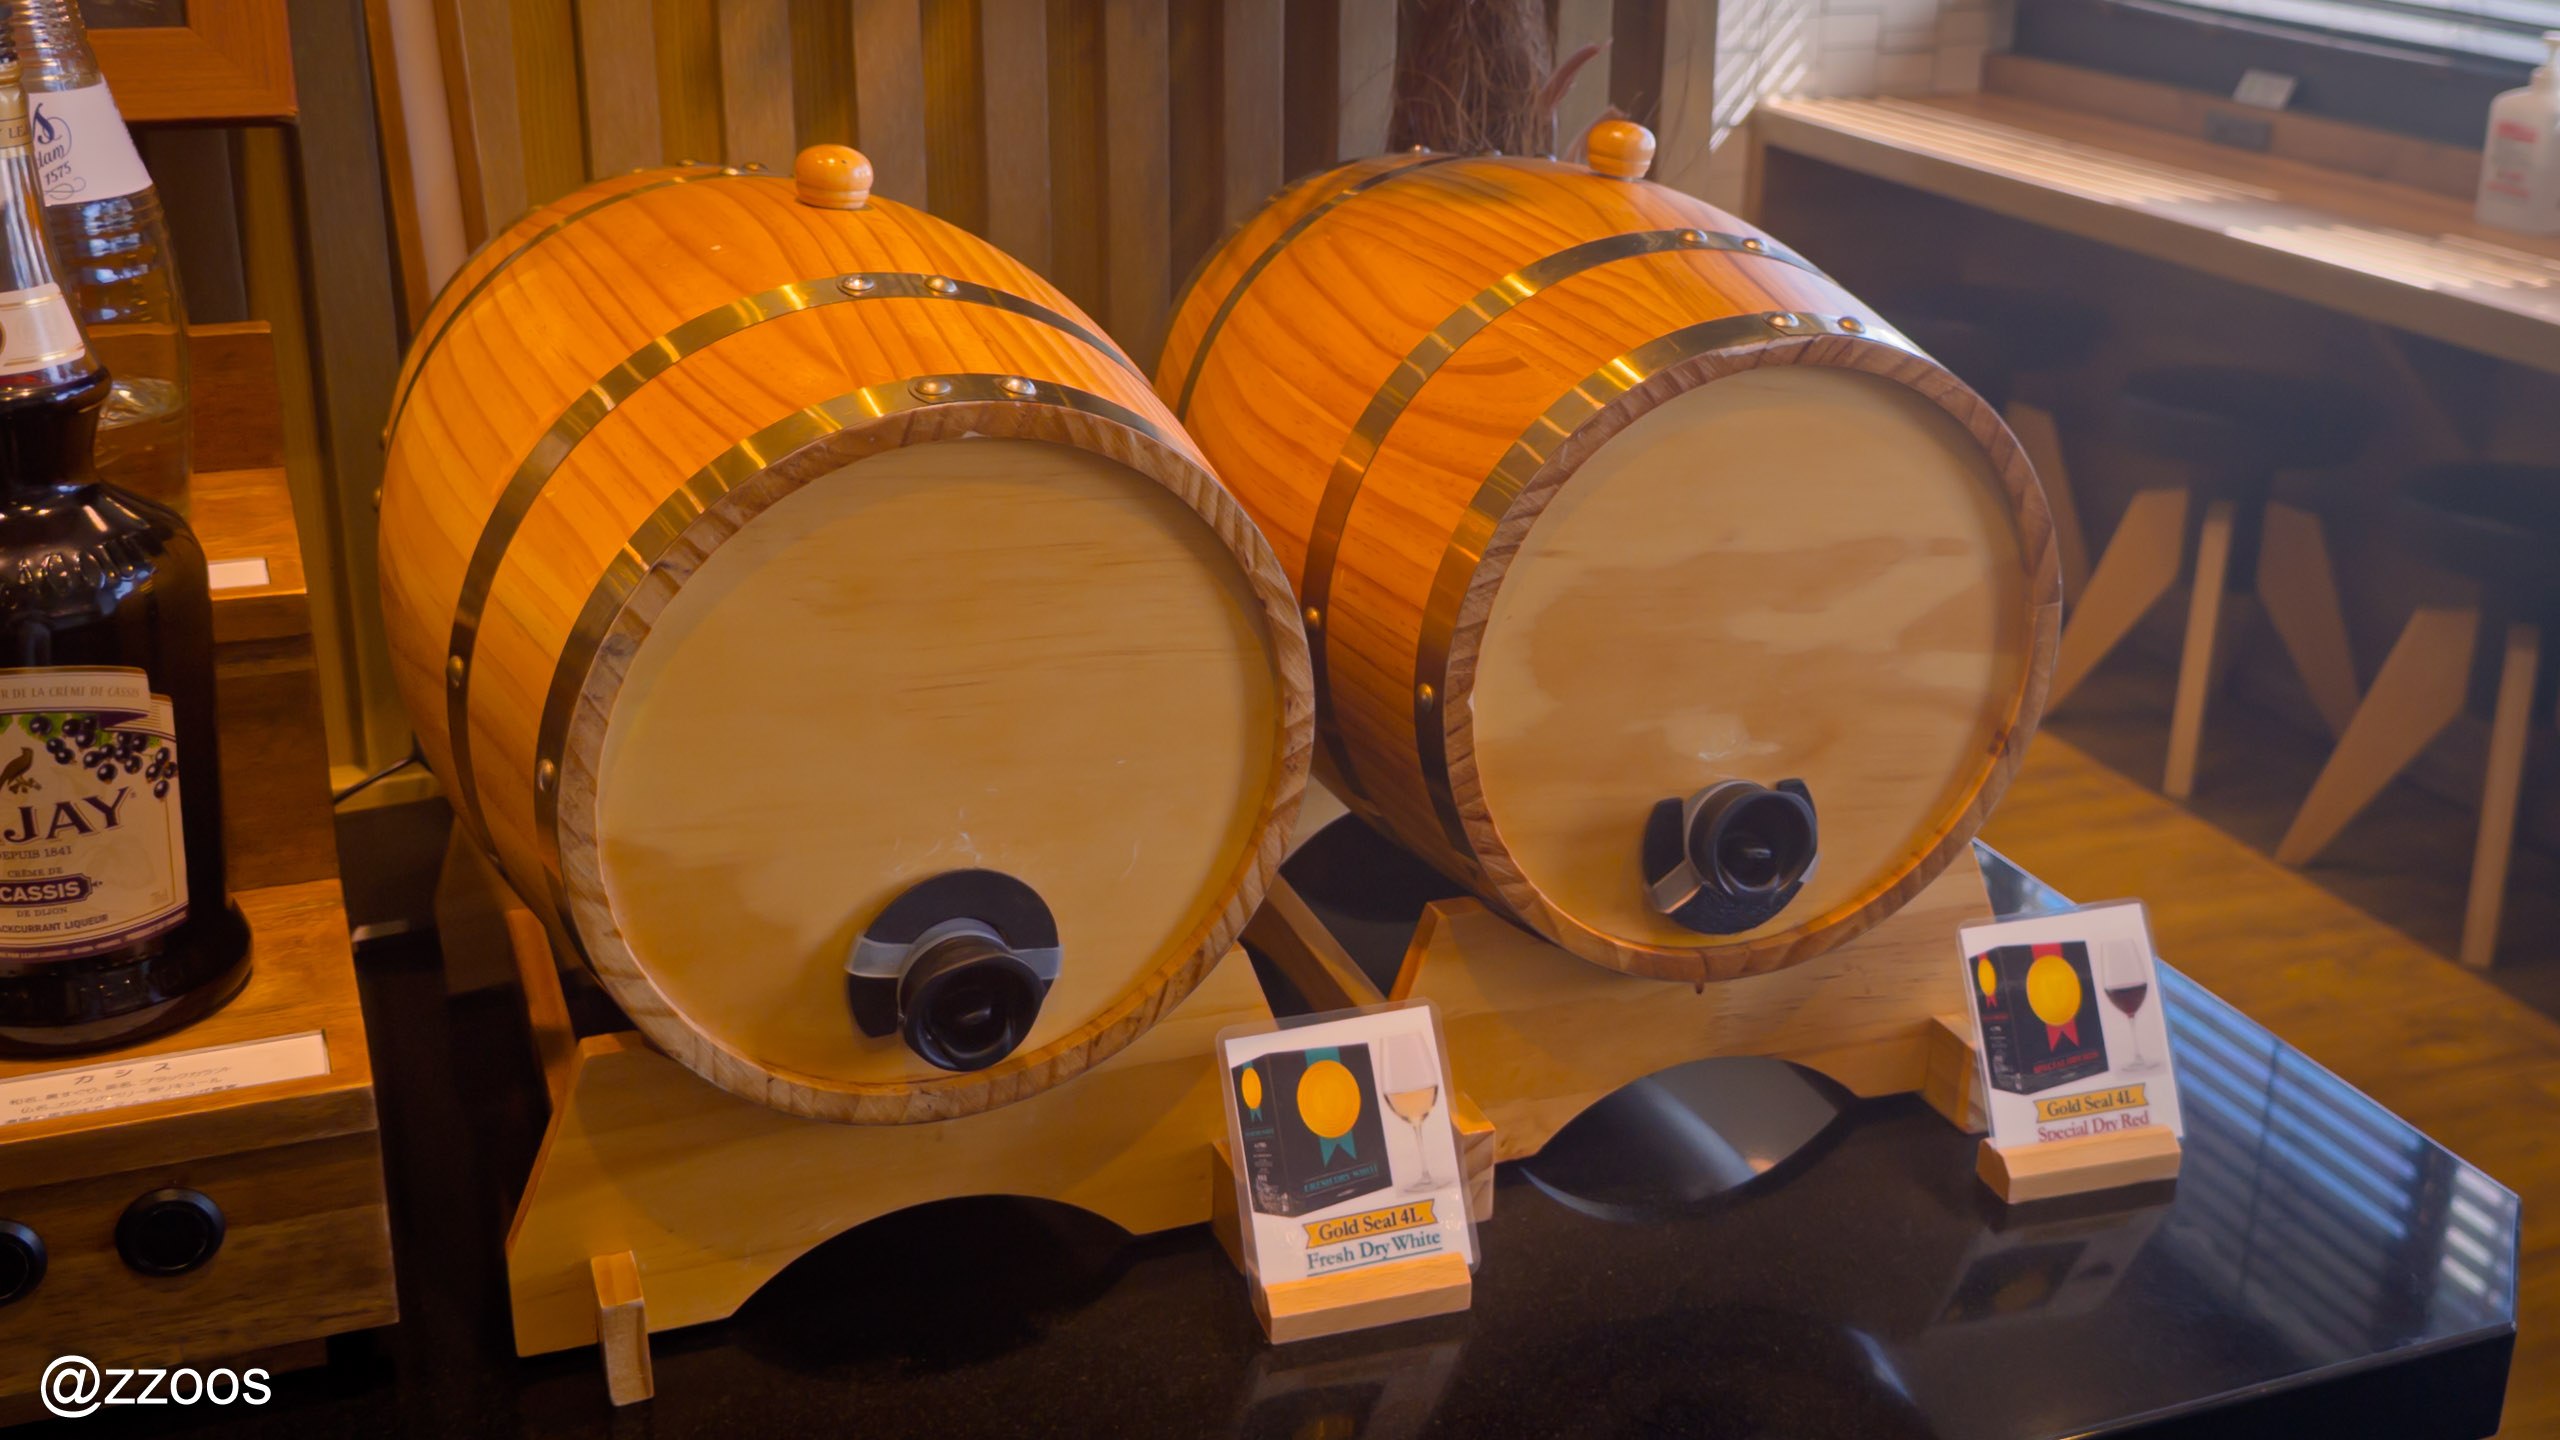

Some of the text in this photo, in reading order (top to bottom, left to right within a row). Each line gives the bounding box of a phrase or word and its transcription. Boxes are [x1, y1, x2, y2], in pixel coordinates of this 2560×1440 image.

[45, 160, 72, 185] 1575
[44, 845, 72, 858] 1841
[0, 880, 81, 903] CASSIS
[64, 914, 108, 930] LIQUEUR
[2047, 1089, 2137, 1117] Gold Seal 4L
[2038, 1110, 2150, 1142] Special Dry Red
[1318, 1207, 1424, 1241] Gold Seal 4L
[1306, 1231, 1441, 1270] Fresh Dry White
